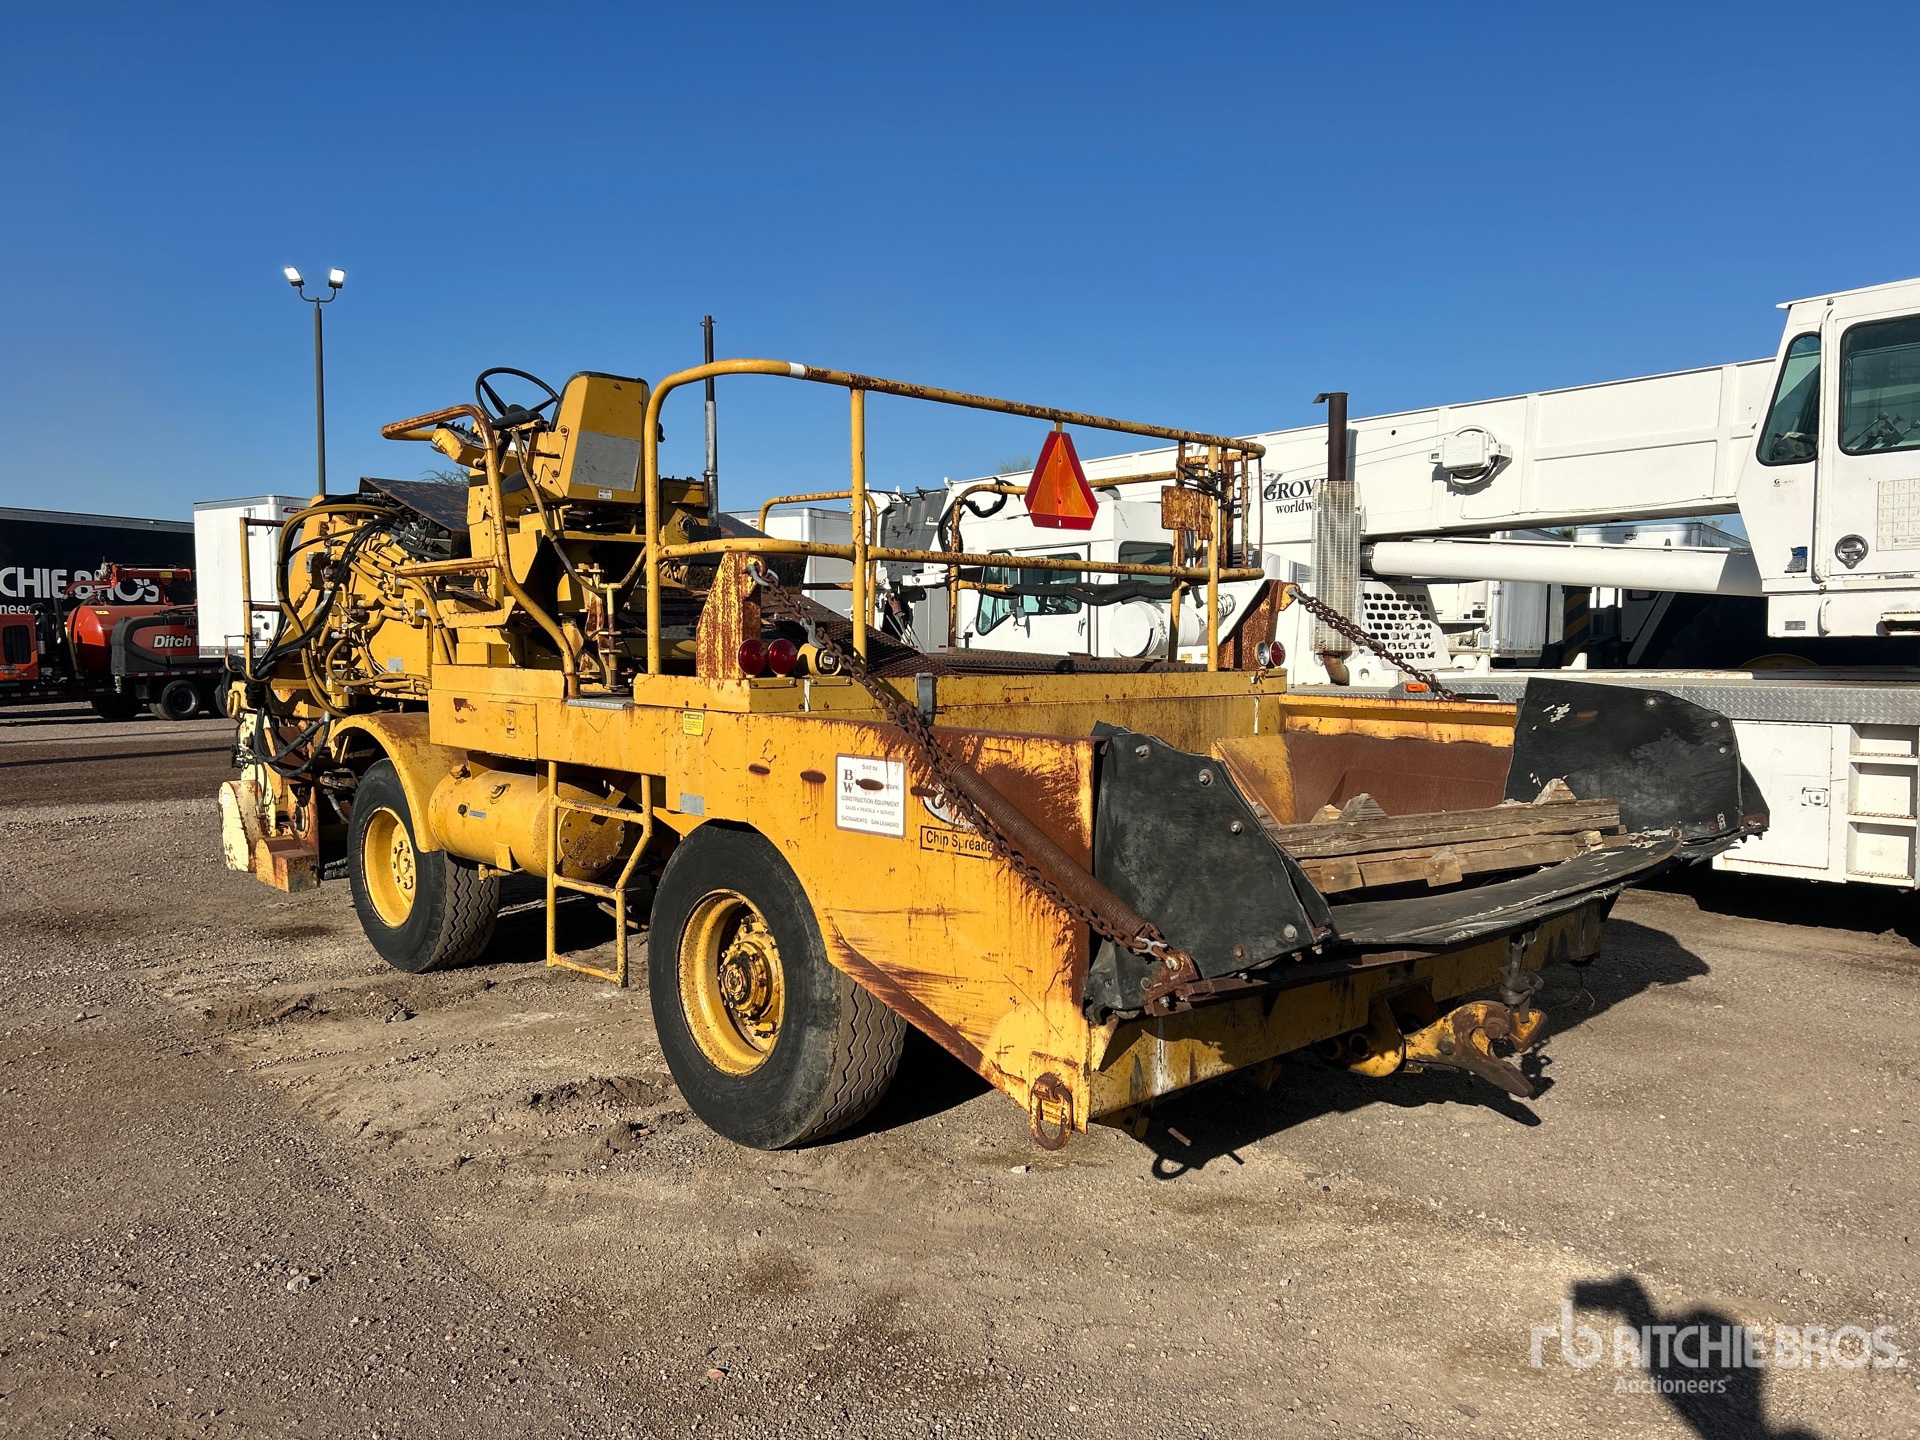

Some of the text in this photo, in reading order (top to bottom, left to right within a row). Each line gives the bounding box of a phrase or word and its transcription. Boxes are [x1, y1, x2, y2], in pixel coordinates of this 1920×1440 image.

[0, 567, 67, 599] CHIE
[0, 603, 39, 616] neer
[153, 635, 192, 648] Ditch
[843, 768, 854, 781] B
[842, 781, 854, 794] W
[841, 795, 900, 808] CONSTRUCTION EQUIPMENT
[841, 815, 868, 824] SACRAMENTO
[880, 821, 900, 829] LEANDRO
[926, 830, 994, 853] Chip Spreade
